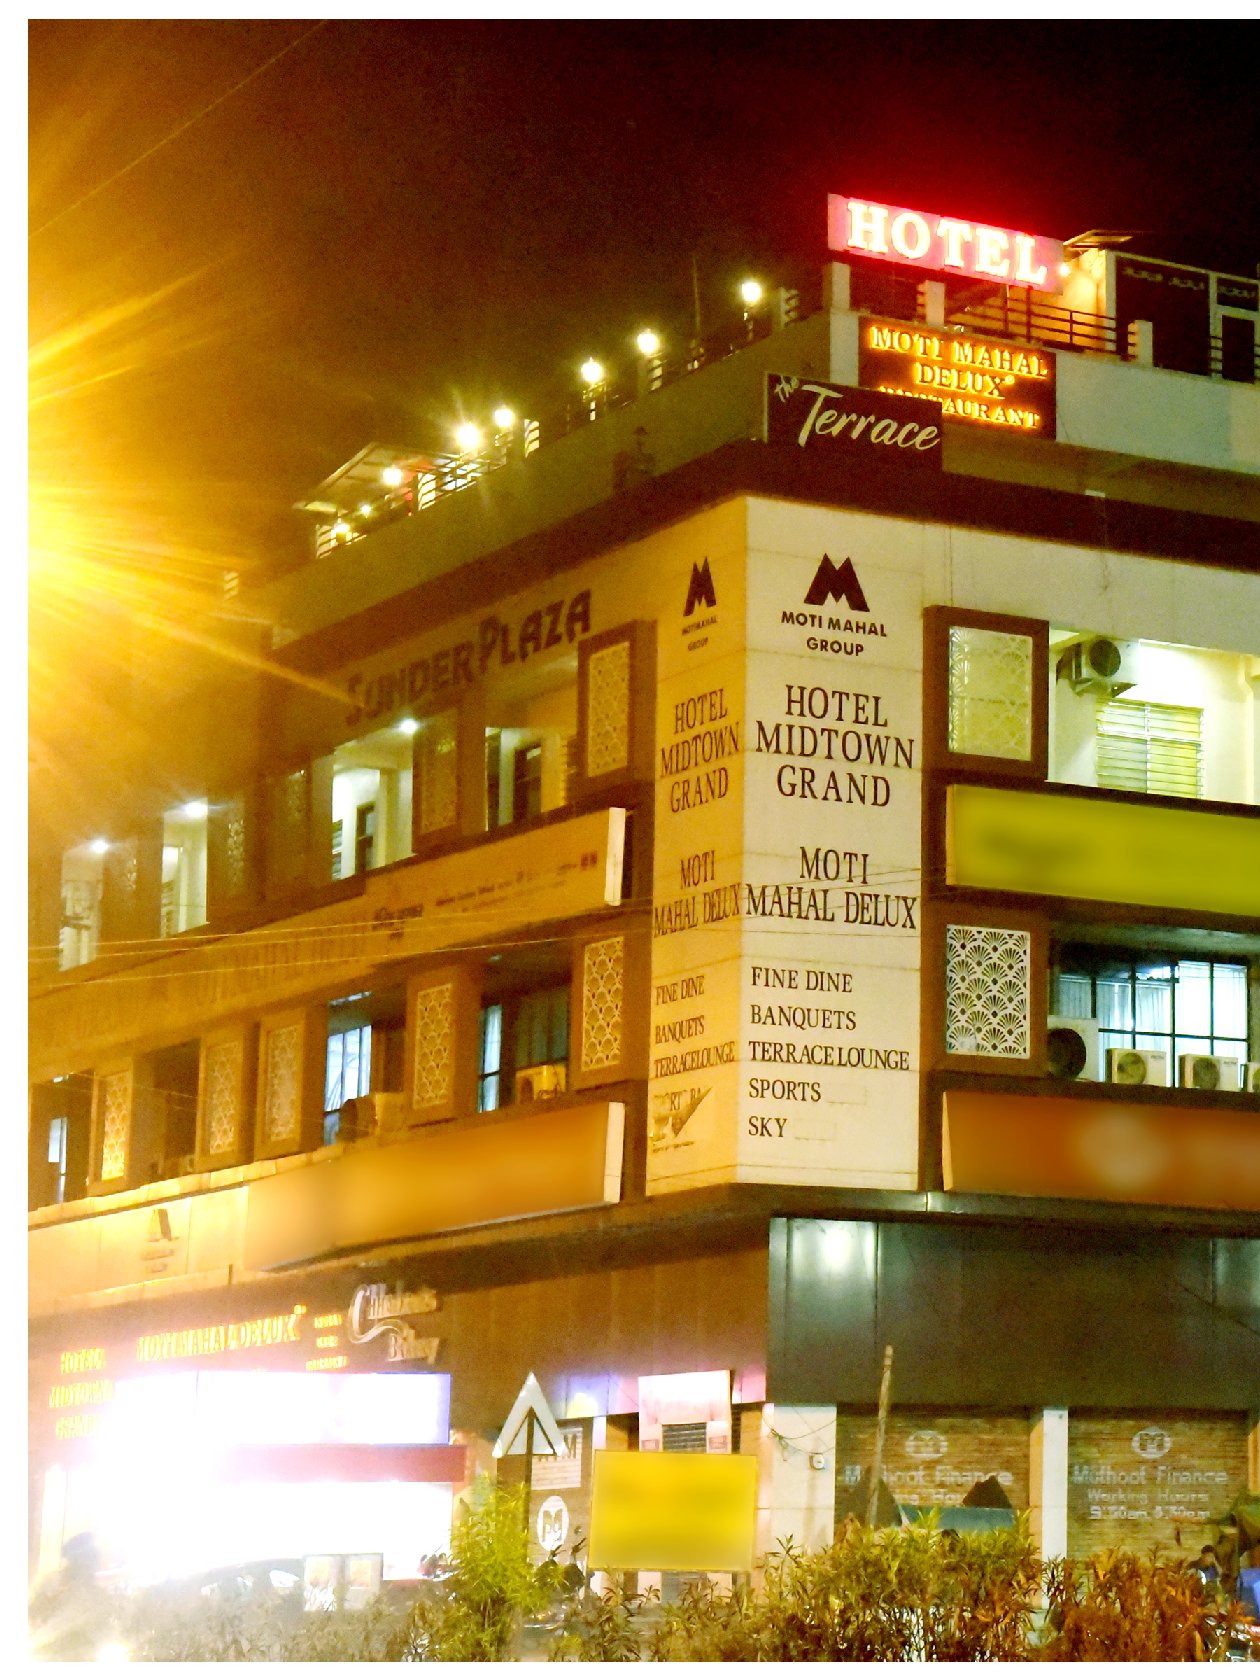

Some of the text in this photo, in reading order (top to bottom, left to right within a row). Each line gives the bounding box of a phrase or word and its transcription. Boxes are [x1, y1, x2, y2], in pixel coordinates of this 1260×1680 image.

[847, 200, 1048, 286] HOTEL
[870, 326, 1049, 379] MOTI MAHAL
[797, 383, 942, 451] Terrace
[879, 385, 1041, 429] AURANT
[781, 610, 888, 638] MOTI MAHAL
[345, 589, 593, 727] SUNDER PLAZA
[806, 637, 864, 656] GROUP
[673, 688, 728, 734] HOTEL
[785, 684, 888, 728] HOTEL
[659, 721, 740, 778] MIDTOWN
[755, 720, 915, 769] MIDTOWN
[670, 767, 729, 813] GRAND
[777, 765, 891, 807] GRAND
[680, 850, 715, 890] MOTI
[800, 847, 869, 884] MOTI
[653, 883, 742, 938] MAHAL DELUX
[746, 884, 917, 930] MAHAL DELUX
[655, 975, 705, 1006] FINE DINE
[751, 967, 853, 993] FINE DINE
[655, 1015, 705, 1044] BANQUETS
[750, 1005, 857, 1031] BANQUETS
[749, 1077, 822, 1102] SPORTS
[748, 1116, 788, 1138] SKY
[1072, 1465, 1229, 1485] Muthoot Finance
